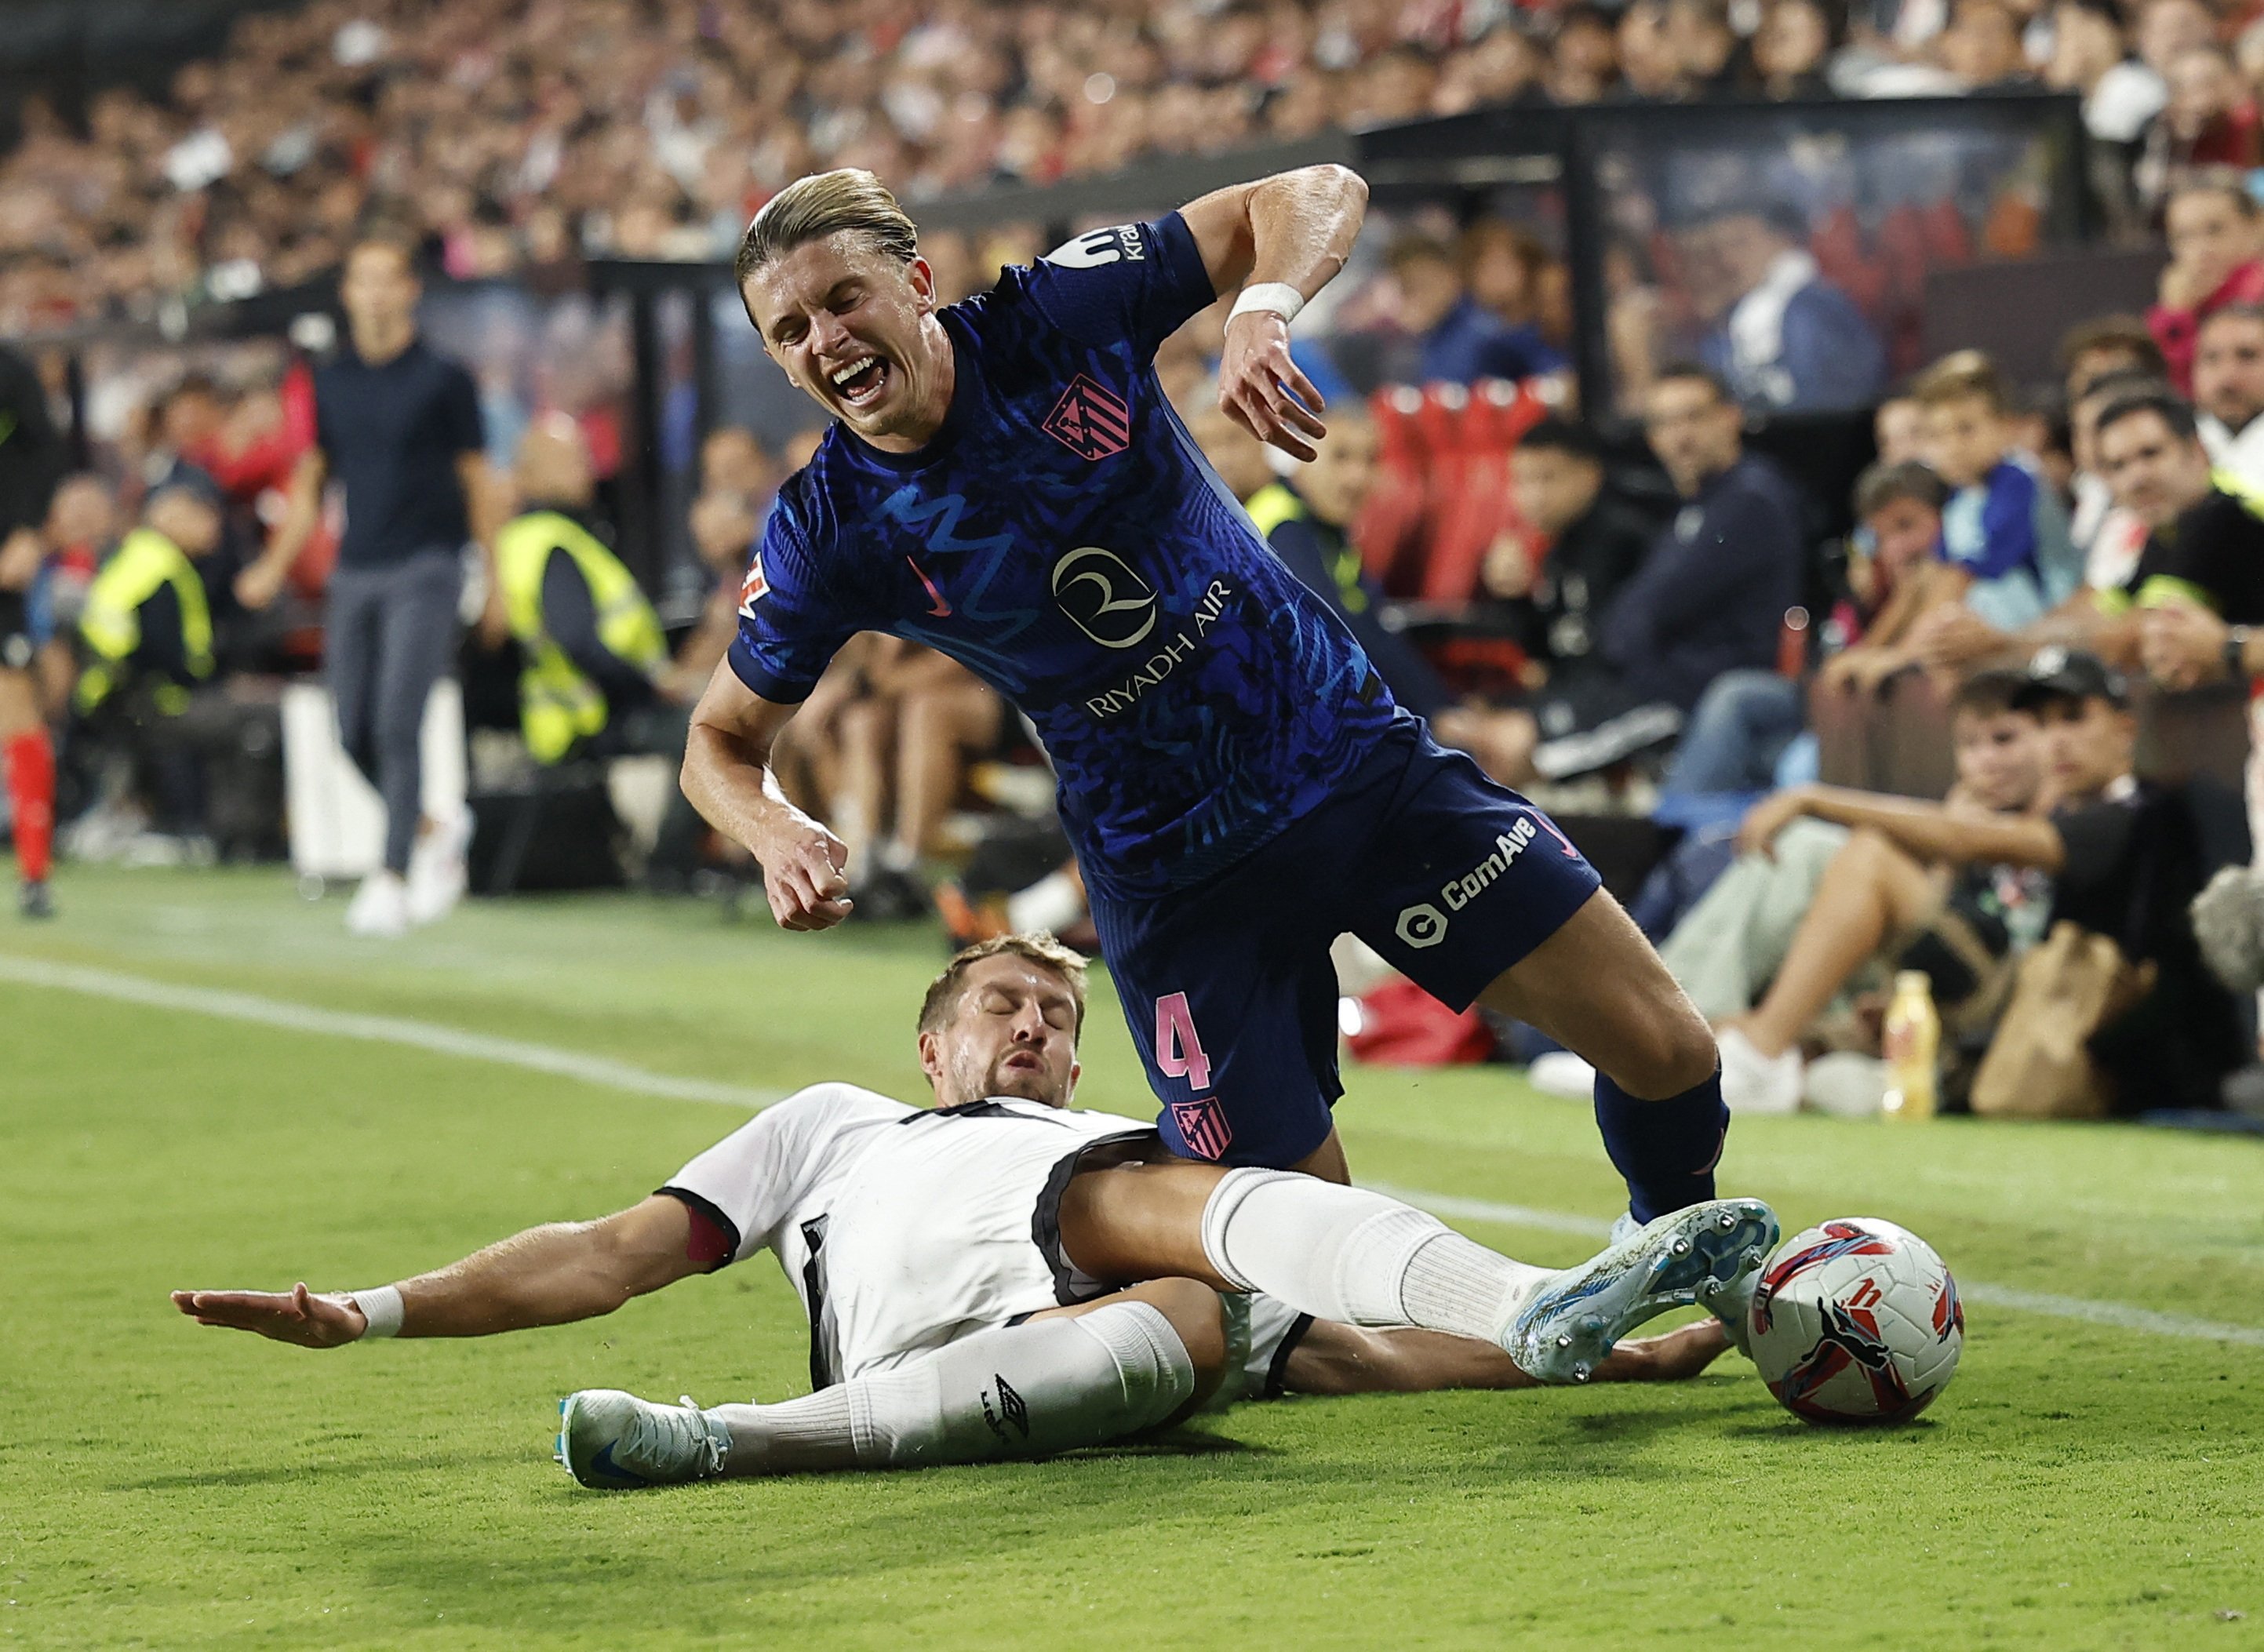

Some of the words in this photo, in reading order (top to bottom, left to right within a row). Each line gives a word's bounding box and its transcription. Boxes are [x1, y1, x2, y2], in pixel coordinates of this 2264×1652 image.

[1085, 632, 1196, 719] RIYADH
[1193, 580, 1232, 637] AIR
[1441, 816, 1537, 912] ComAve
[1156, 991, 1210, 1090] 4
